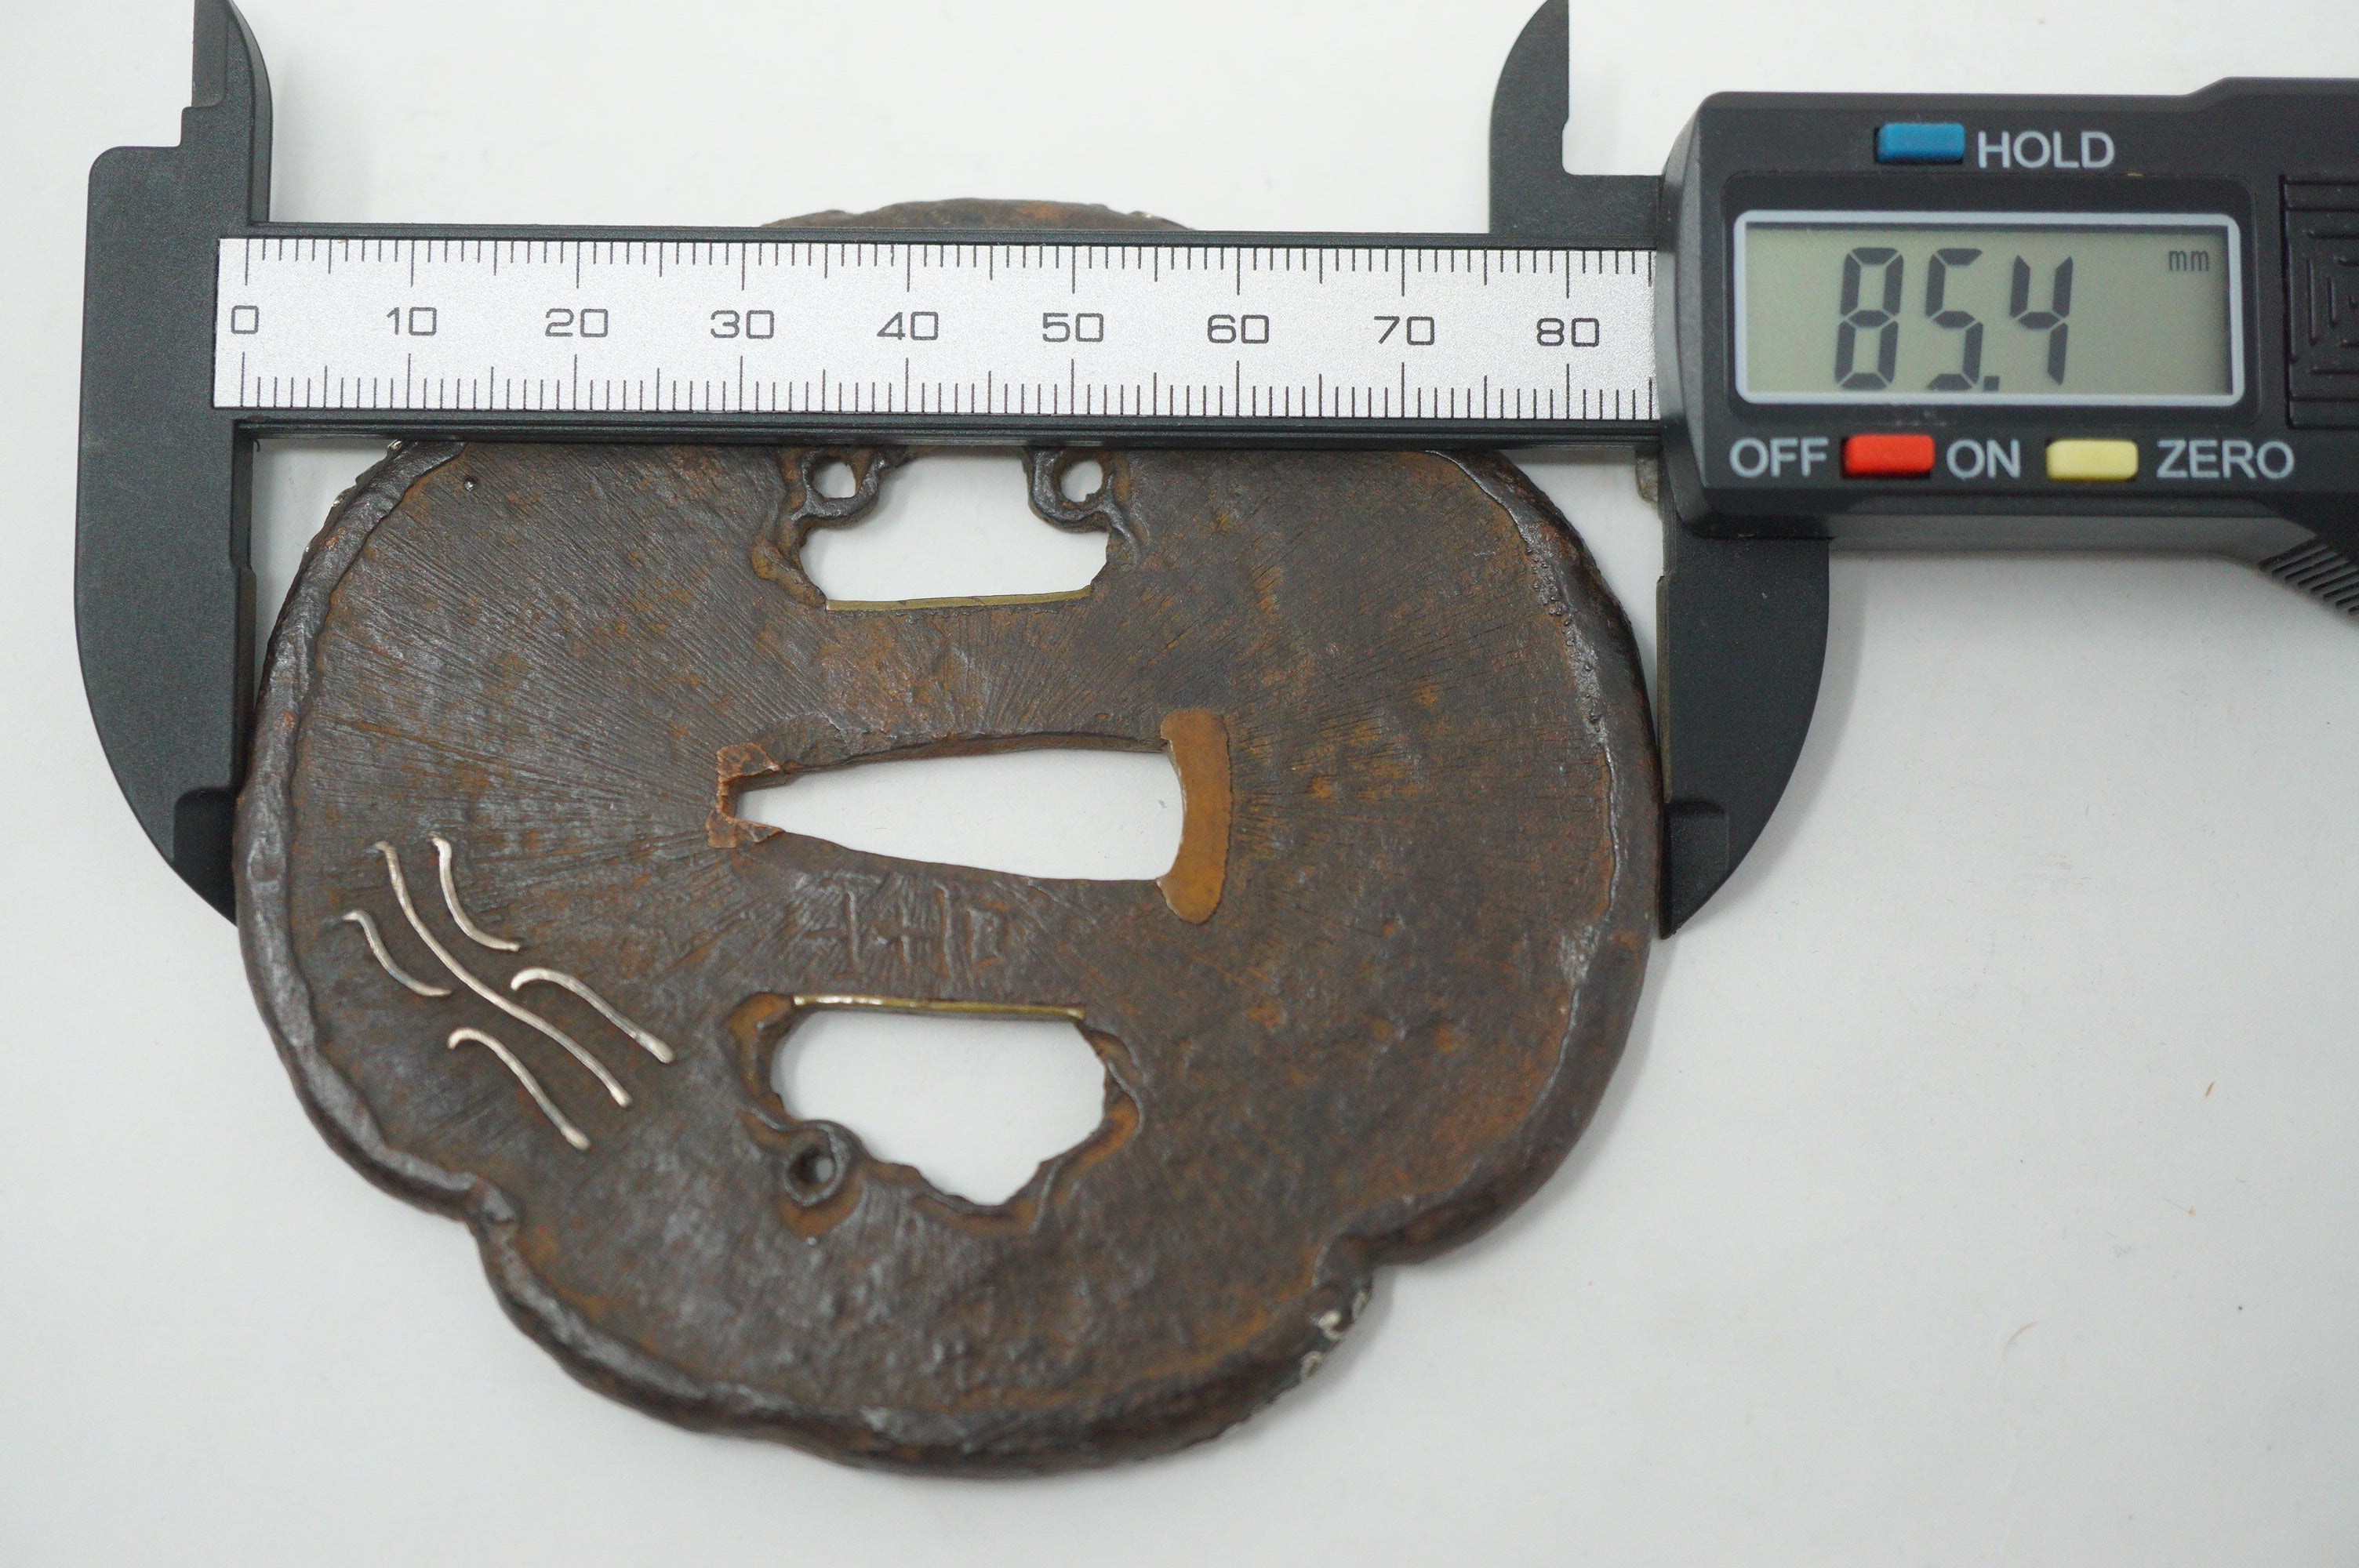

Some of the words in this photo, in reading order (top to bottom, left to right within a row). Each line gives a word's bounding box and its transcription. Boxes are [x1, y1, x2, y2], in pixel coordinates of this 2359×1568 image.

[1978, 131, 2115, 169] HOLD
[231, 305, 260, 335] 0
[386, 307, 437, 336] 10
[545, 308, 609, 338] 20
[711, 310, 774, 339] 30
[877, 311, 939, 341] 40
[1042, 312, 1104, 343] 50
[1207, 314, 1270, 344] 60
[1373, 315, 1435, 346] 70
[1536, 318, 1600, 347] 80
[1835, 247, 2074, 391] 85.4
[2168, 249, 2211, 272] mm
[1729, 437, 1829, 477] OFF
[1946, 440, 2020, 477] ON
[2157, 440, 2295, 479] ZERO
